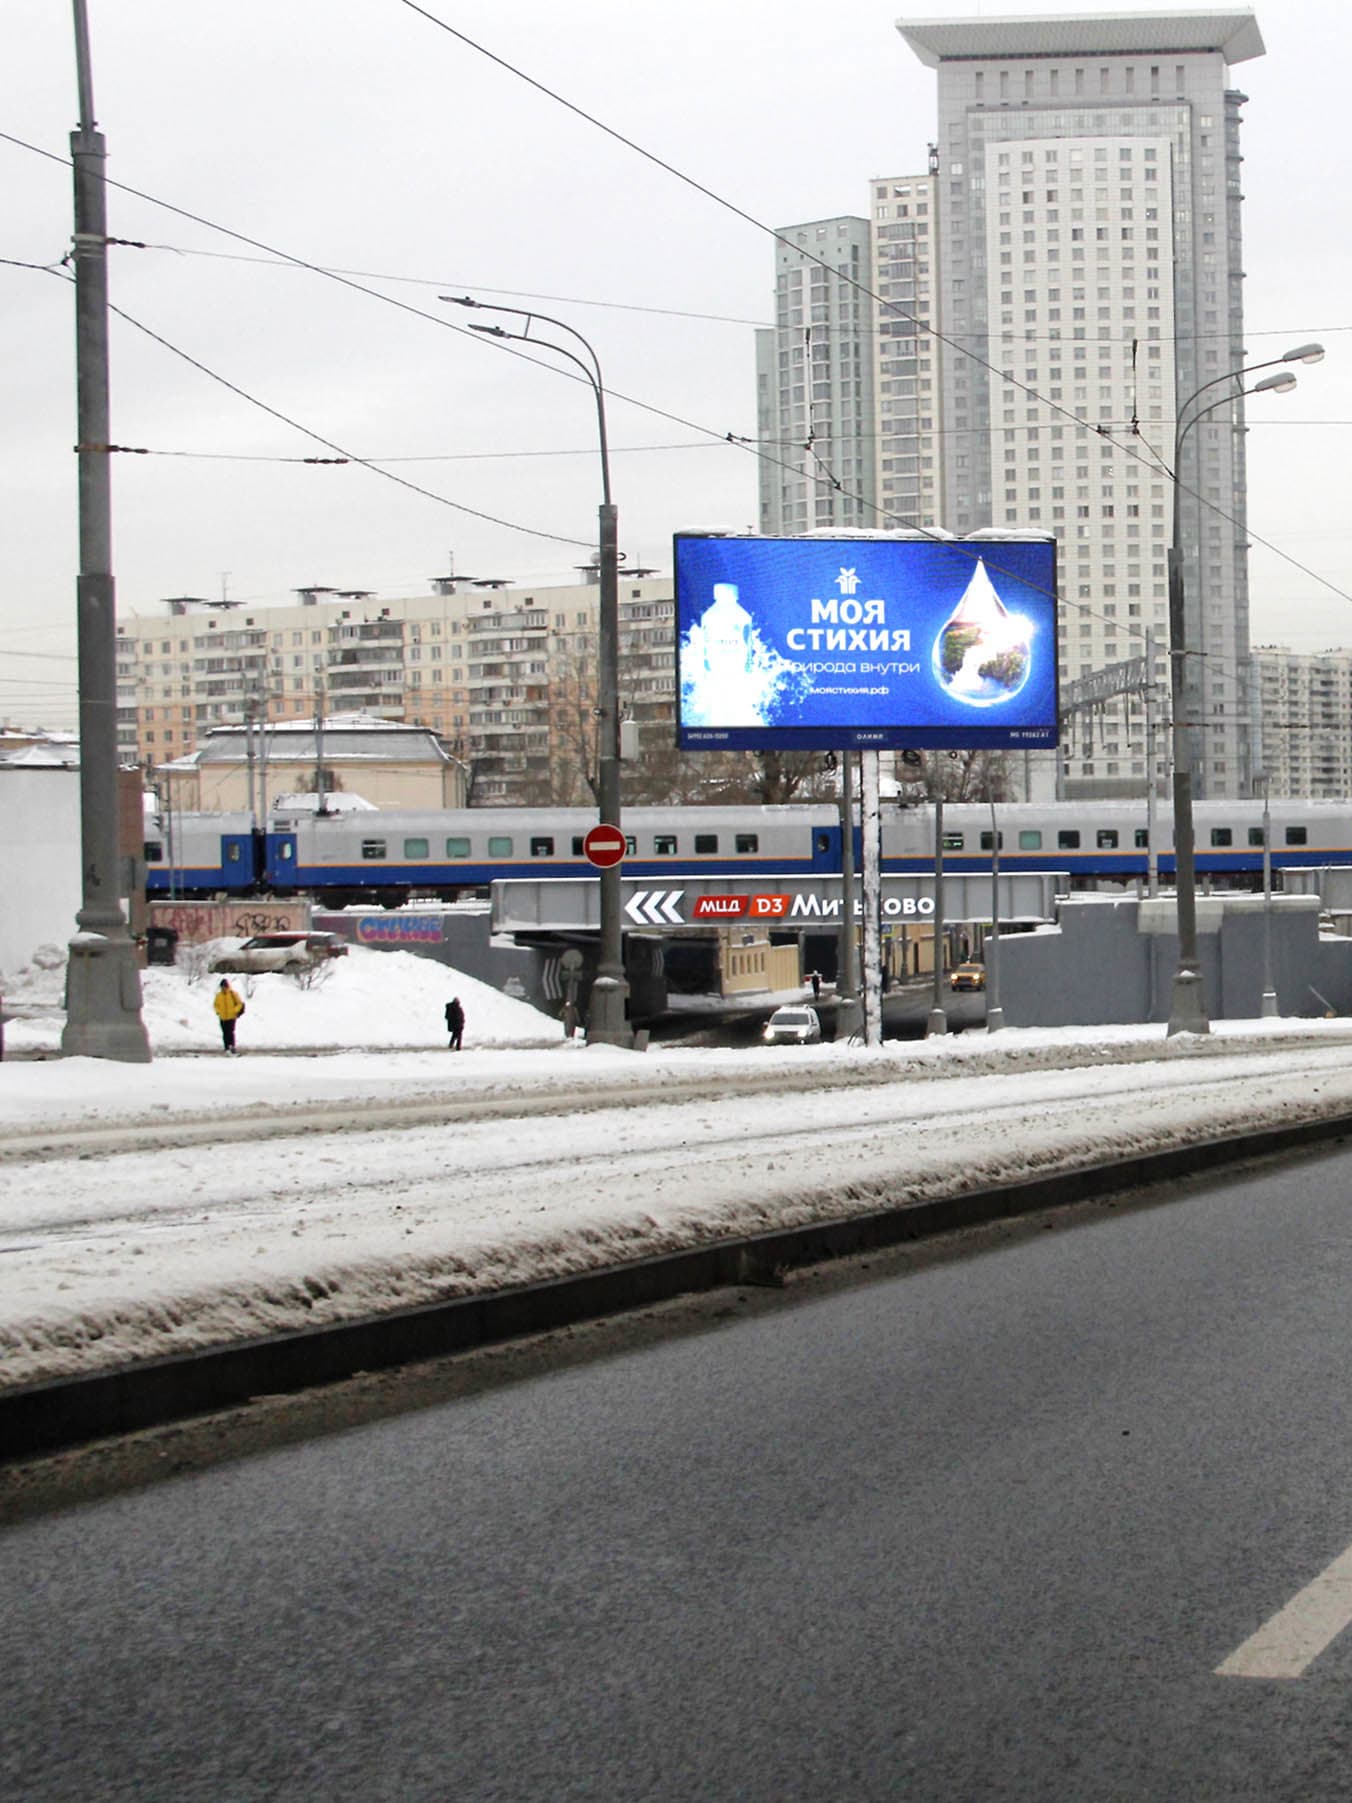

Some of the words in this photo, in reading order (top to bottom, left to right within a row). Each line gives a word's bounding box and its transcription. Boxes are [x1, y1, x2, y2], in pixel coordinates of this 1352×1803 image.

[811, 599, 886, 625] МОЯ
[786, 628, 911, 652] СТИХИЯ
[860, 662, 921, 675] внутри
[810, 686, 890, 695] моястихия.рф
[699, 900, 741, 912] МЦД
[757, 898, 783, 912] D3
